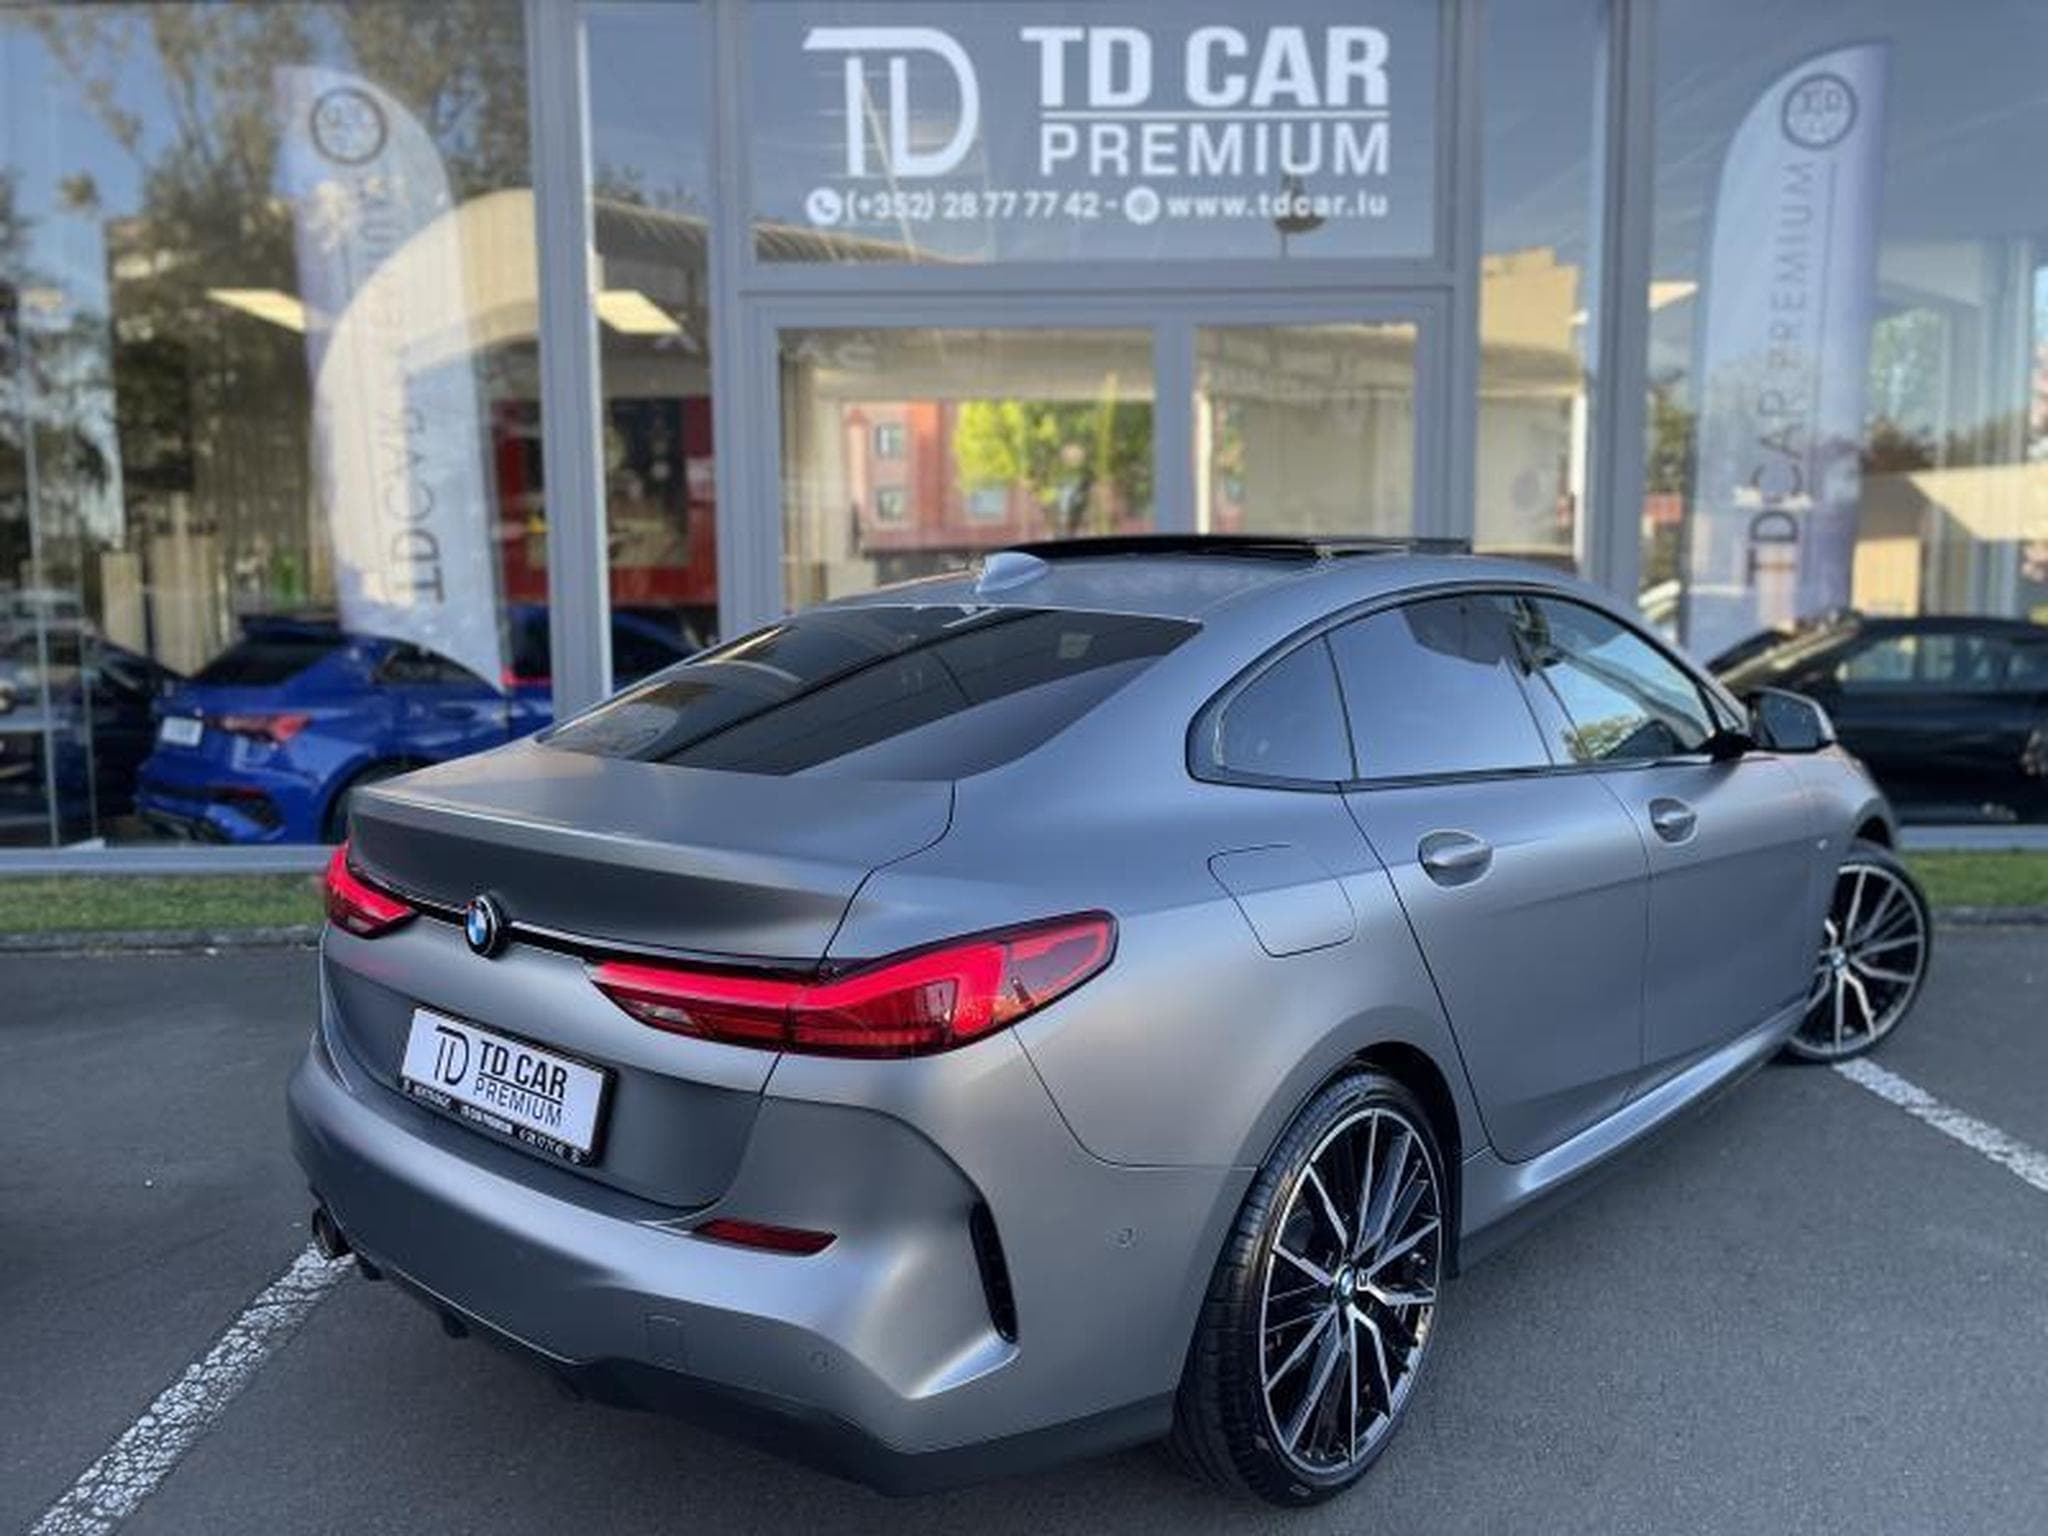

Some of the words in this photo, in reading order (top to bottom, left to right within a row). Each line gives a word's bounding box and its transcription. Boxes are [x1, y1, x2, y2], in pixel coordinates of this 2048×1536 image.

[1020, 26, 1153, 108] TD
[1186, 26, 1392, 109] CAR
[1040, 122, 1392, 176] PREMIUM
[1167, 190, 1389, 217] www.tdcar.lu
[1766, 160, 1814, 371] PREMIUM
[477, 1040, 511, 1077] TD
[514, 1053, 568, 1100] CAR
[473, 1076, 563, 1128] PREMIUM
